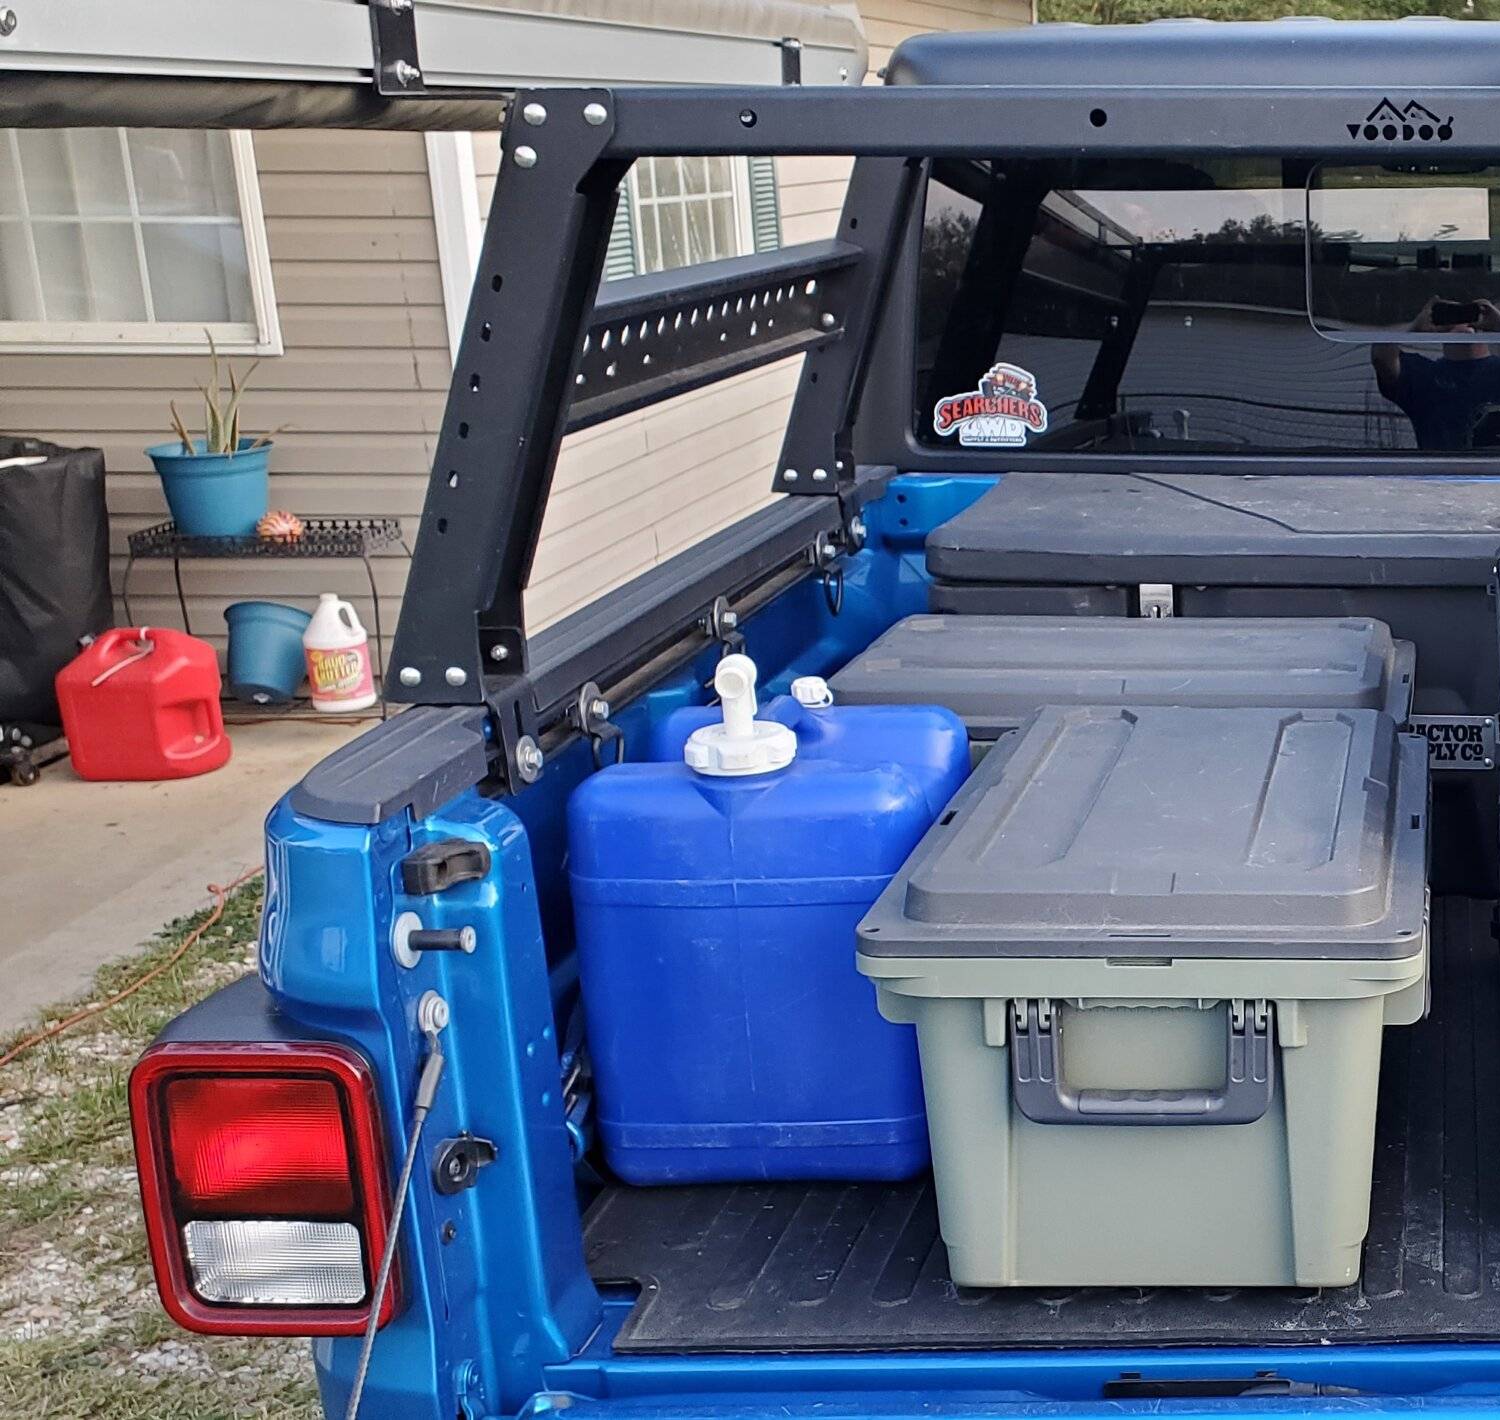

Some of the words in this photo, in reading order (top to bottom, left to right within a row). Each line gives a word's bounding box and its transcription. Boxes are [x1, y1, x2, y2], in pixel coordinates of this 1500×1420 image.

[1346, 117, 1454, 142] VOODOO
[938, 395, 1042, 430] SEARCHERS
[962, 417, 1024, 437] 4WD
